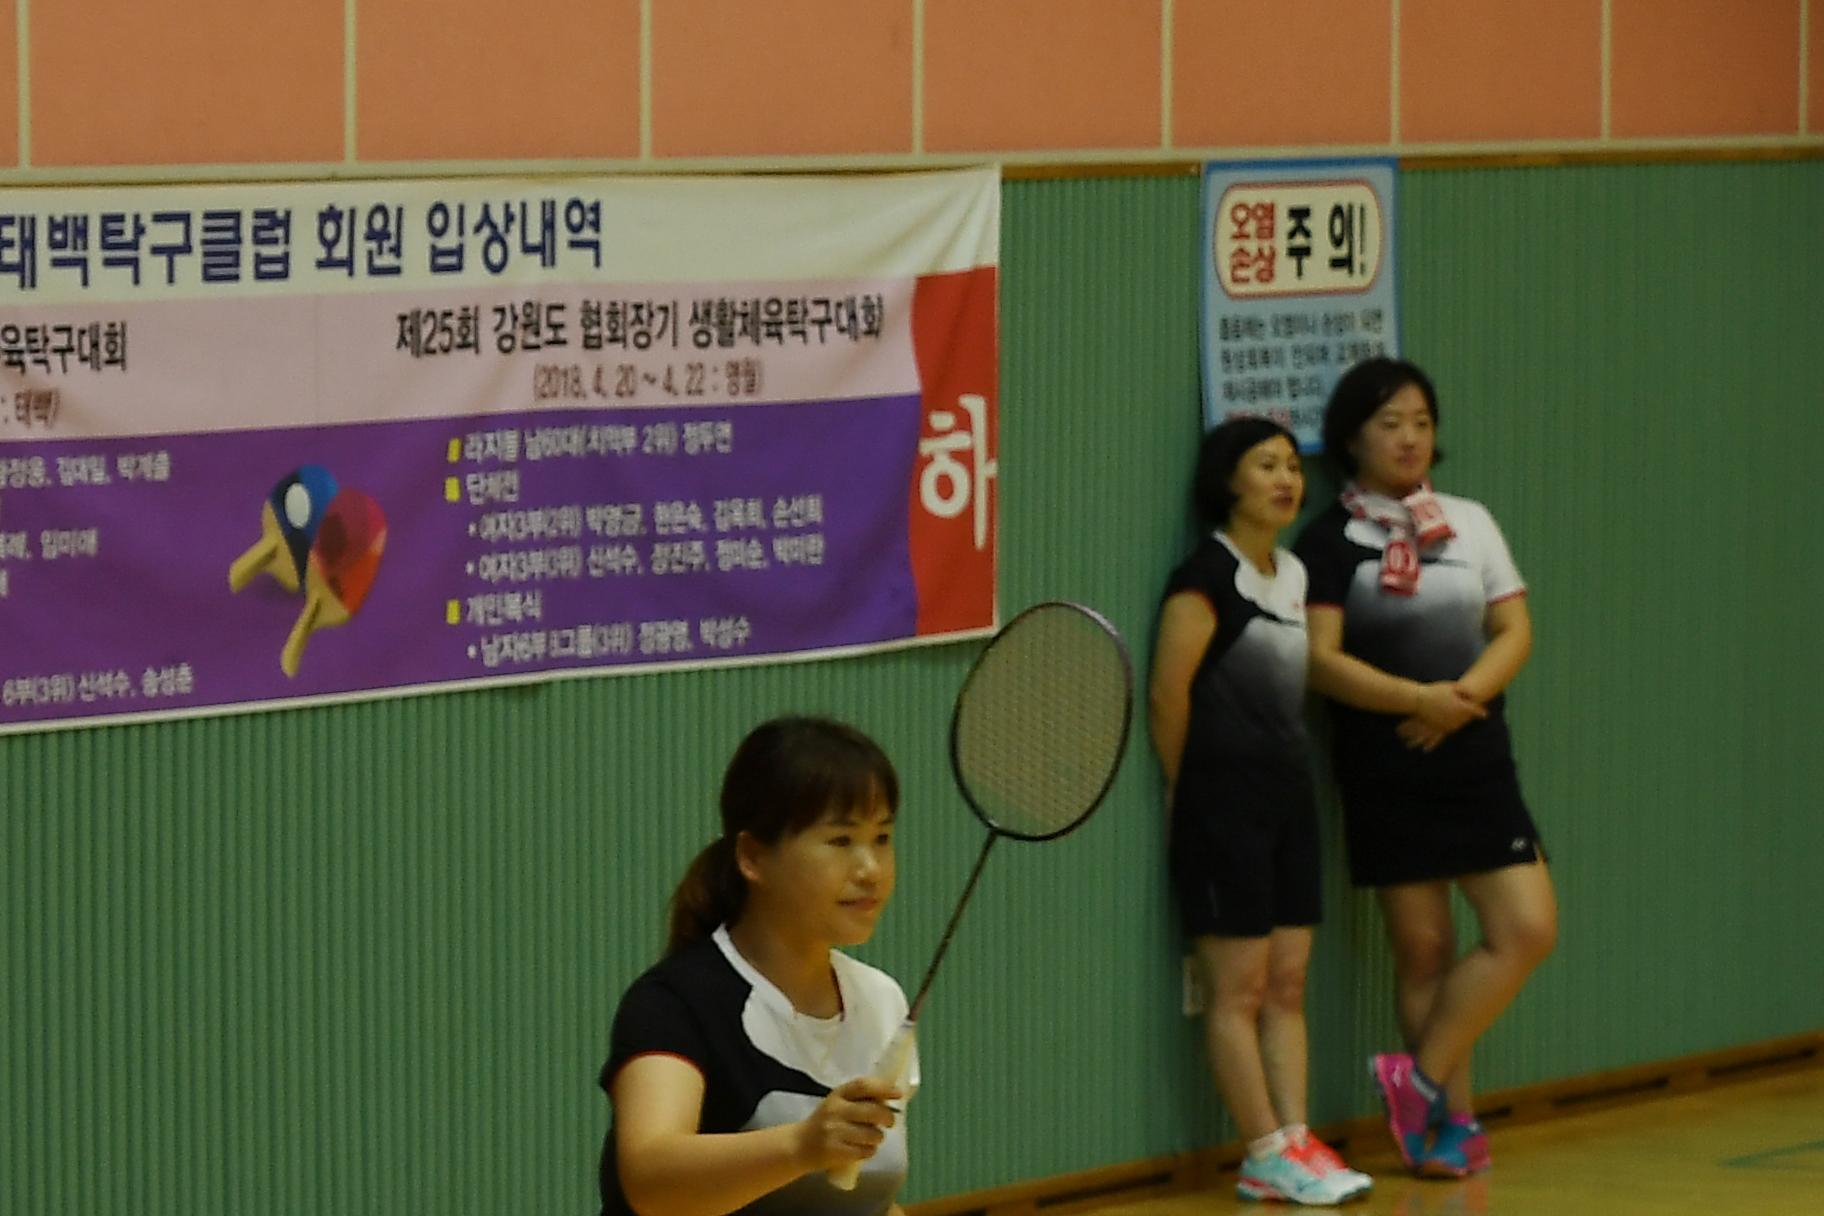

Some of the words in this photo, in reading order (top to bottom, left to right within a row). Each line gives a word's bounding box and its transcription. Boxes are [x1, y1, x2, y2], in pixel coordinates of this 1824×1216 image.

[315, 200, 404, 279] 회원
[426, 197, 603, 275] 입상내역
[1286, 203, 1367, 279] 주의!
[396, 303, 481, 358] 제25회
[493, 301, 567, 355] 강원도
[579, 297, 679, 350] 협회장기
[688, 293, 884, 348] 생활체육탁구대회
[920, 392, 999, 548] 하
